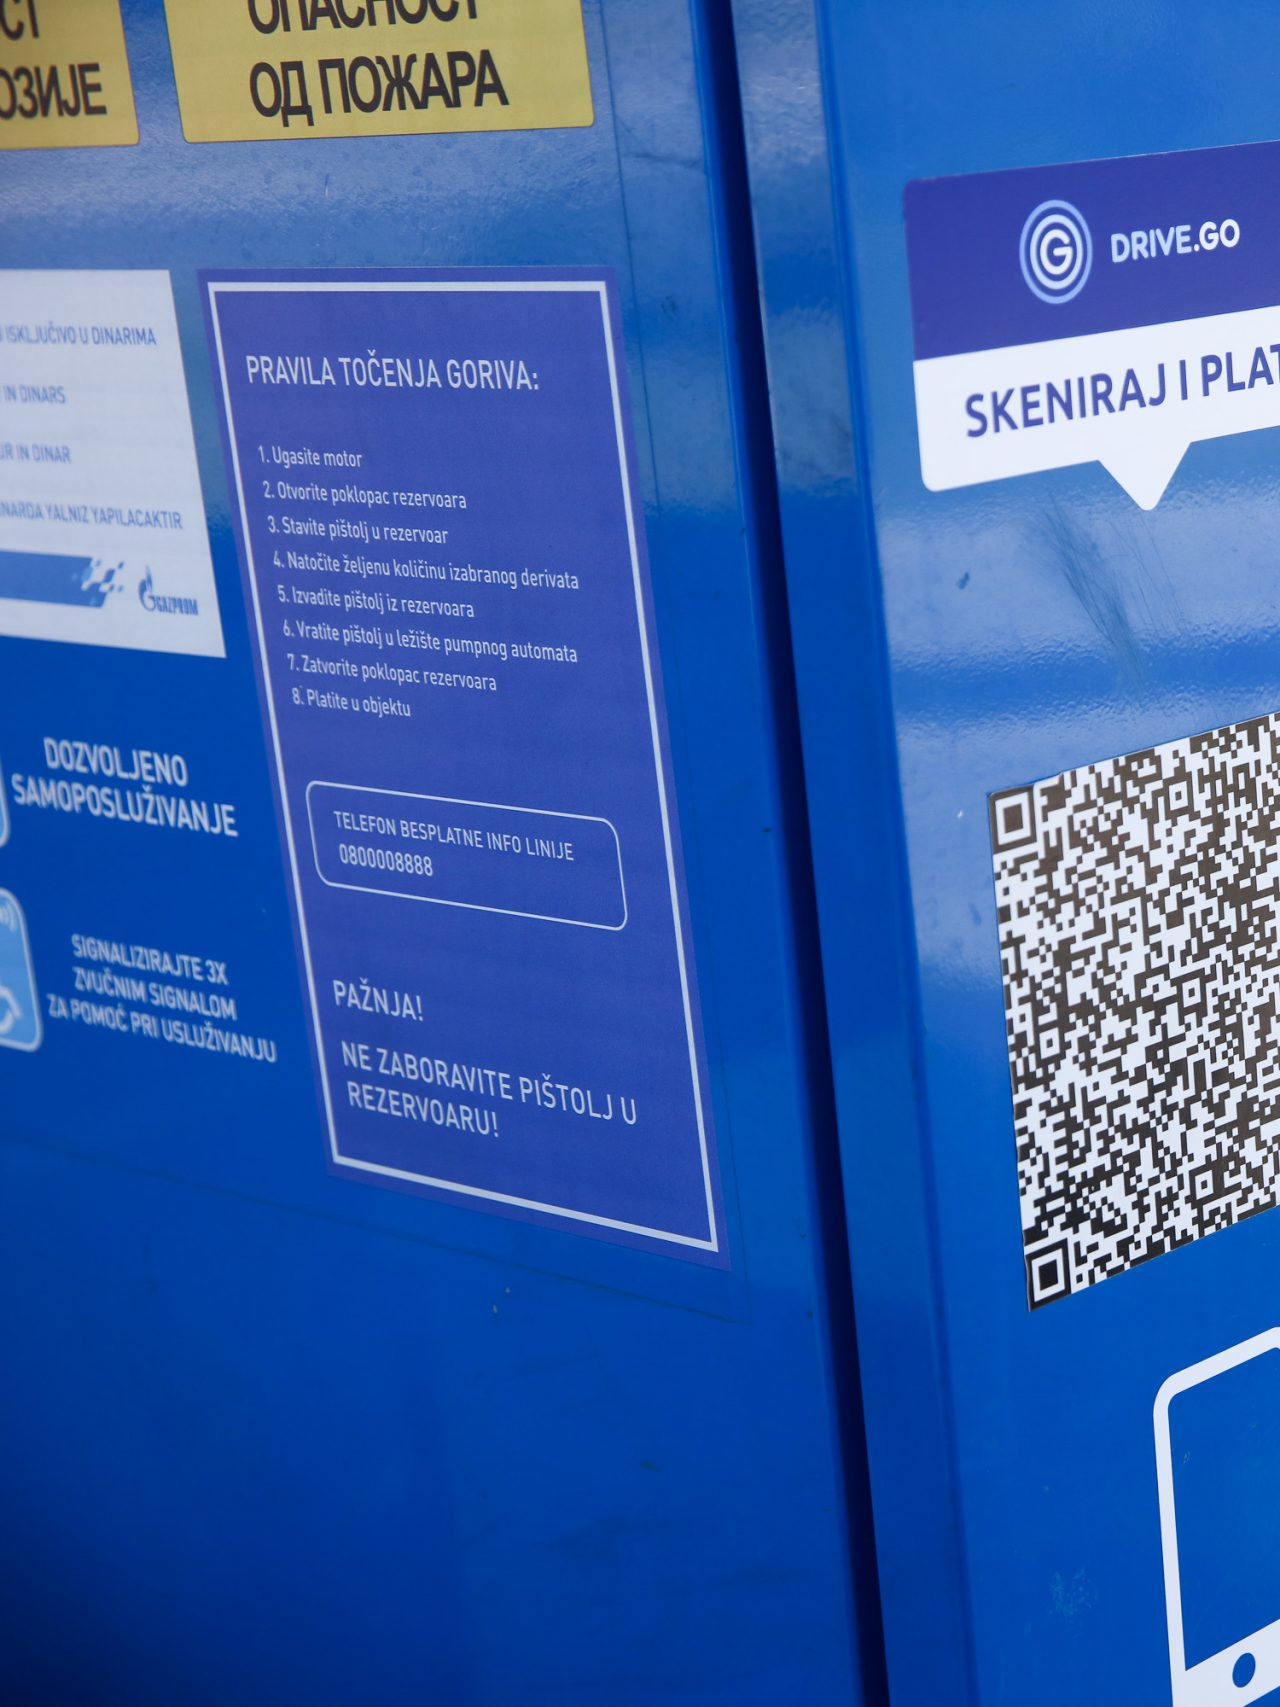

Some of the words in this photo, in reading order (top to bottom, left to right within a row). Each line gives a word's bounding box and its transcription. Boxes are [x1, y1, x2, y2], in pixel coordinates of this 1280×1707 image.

[250, 61, 314, 127] ОД
[318, 49, 510, 113] ПОЖАРА
[1110, 218, 1240, 263] DRIVE.GO
[79, 325, 88, 344] U
[91, 325, 157, 346] DINARIMA
[246, 355, 336, 385] PRAVILA
[338, 349, 442, 388] TOČENJA
[447, 359, 540, 391] GORIVA:
[3, 383, 17, 402] IN
[19, 384, 66, 404] DINARS
[965, 363, 1166, 438] SKENIRAJ
[1178, 359, 1189, 401] I
[16, 443, 30, 461] IN
[32, 443, 72, 463] DINAR
[258, 445, 270, 463] 1.
[272, 446, 320, 469] Ugasite
[323, 450, 362, 467] motor
[262, 480, 275, 498] 2.
[277, 481, 328, 501] Otvorite
[331, 485, 390, 508] poklopac
[393, 491, 467, 509] rezervoara
[45, 503, 89, 524] YALNIZ
[91, 505, 183, 530] YAPILACAKTIR
[267, 515, 280, 533] 3.
[282, 516, 326, 536] Stavite
[329, 518, 370, 543] pištolj
[372, 526, 381, 540] u
[383, 527, 448, 544] rezervoar
[273, 550, 285, 568] 4.
[287, 551, 340, 572] Natočite
[343, 554, 391, 578] željenu
[393, 559, 446, 580] količinu
[448, 562, 518, 590] izabranog
[521, 567, 579, 589] derivata
[277, 584, 290, 603] 5.
[292, 586, 341, 606] Izvadite
[344, 590, 384, 614] pištolj
[386, 593, 398, 611] iz
[401, 599, 475, 618] rezervoara
[283, 619, 295, 637] 6.
[296, 620, 340, 641] Vratite
[342, 624, 383, 650] pištolj
[385, 633, 394, 646] u
[396, 629, 441, 650] ležište
[444, 637, 508, 661] pumpnog
[511, 642, 578, 663] automata
[287, 653, 300, 671] 7.
[301, 655, 358, 677] Zatvorite
[361, 662, 420, 686] poklopac
[423, 670, 497, 692] rezervoara
[292, 687, 304, 705] 8.
[306, 689, 348, 710] Platite
[351, 698, 360, 712] u
[363, 696, 411, 718] objektu
[43, 737, 189, 787] DOZVOLJENO
[11, 773, 239, 838] SAMOPOSLUŽIVANJE
[333, 810, 396, 836] TELEFON
[400, 820, 484, 849] BESPLATNE
[487, 832, 522, 854] INFO
[525, 837, 575, 861] LINIJE
[338, 843, 434, 877] 0800008888
[71, 933, 204, 982] SIGNALIZIRAJTE
[205, 959, 230, 986] 3X
[72, 966, 147, 1002] ZVUČNIM
[149, 982, 238, 1021] SIGNALOM
[332, 977, 424, 1022] PAŽNJA!
[47, 993, 69, 1019] ZA
[130, 1011, 160, 1039] PRI
[161, 1018, 277, 1064] USLUŽIVANJU
[341, 1040, 372, 1072] NE
[376, 1048, 513, 1101] ZABORAVITE
[519, 1072, 614, 1121] PIŠTOLJ
[620, 1098, 638, 1125] U
[347, 1080, 499, 1138] REZERVOARU!
